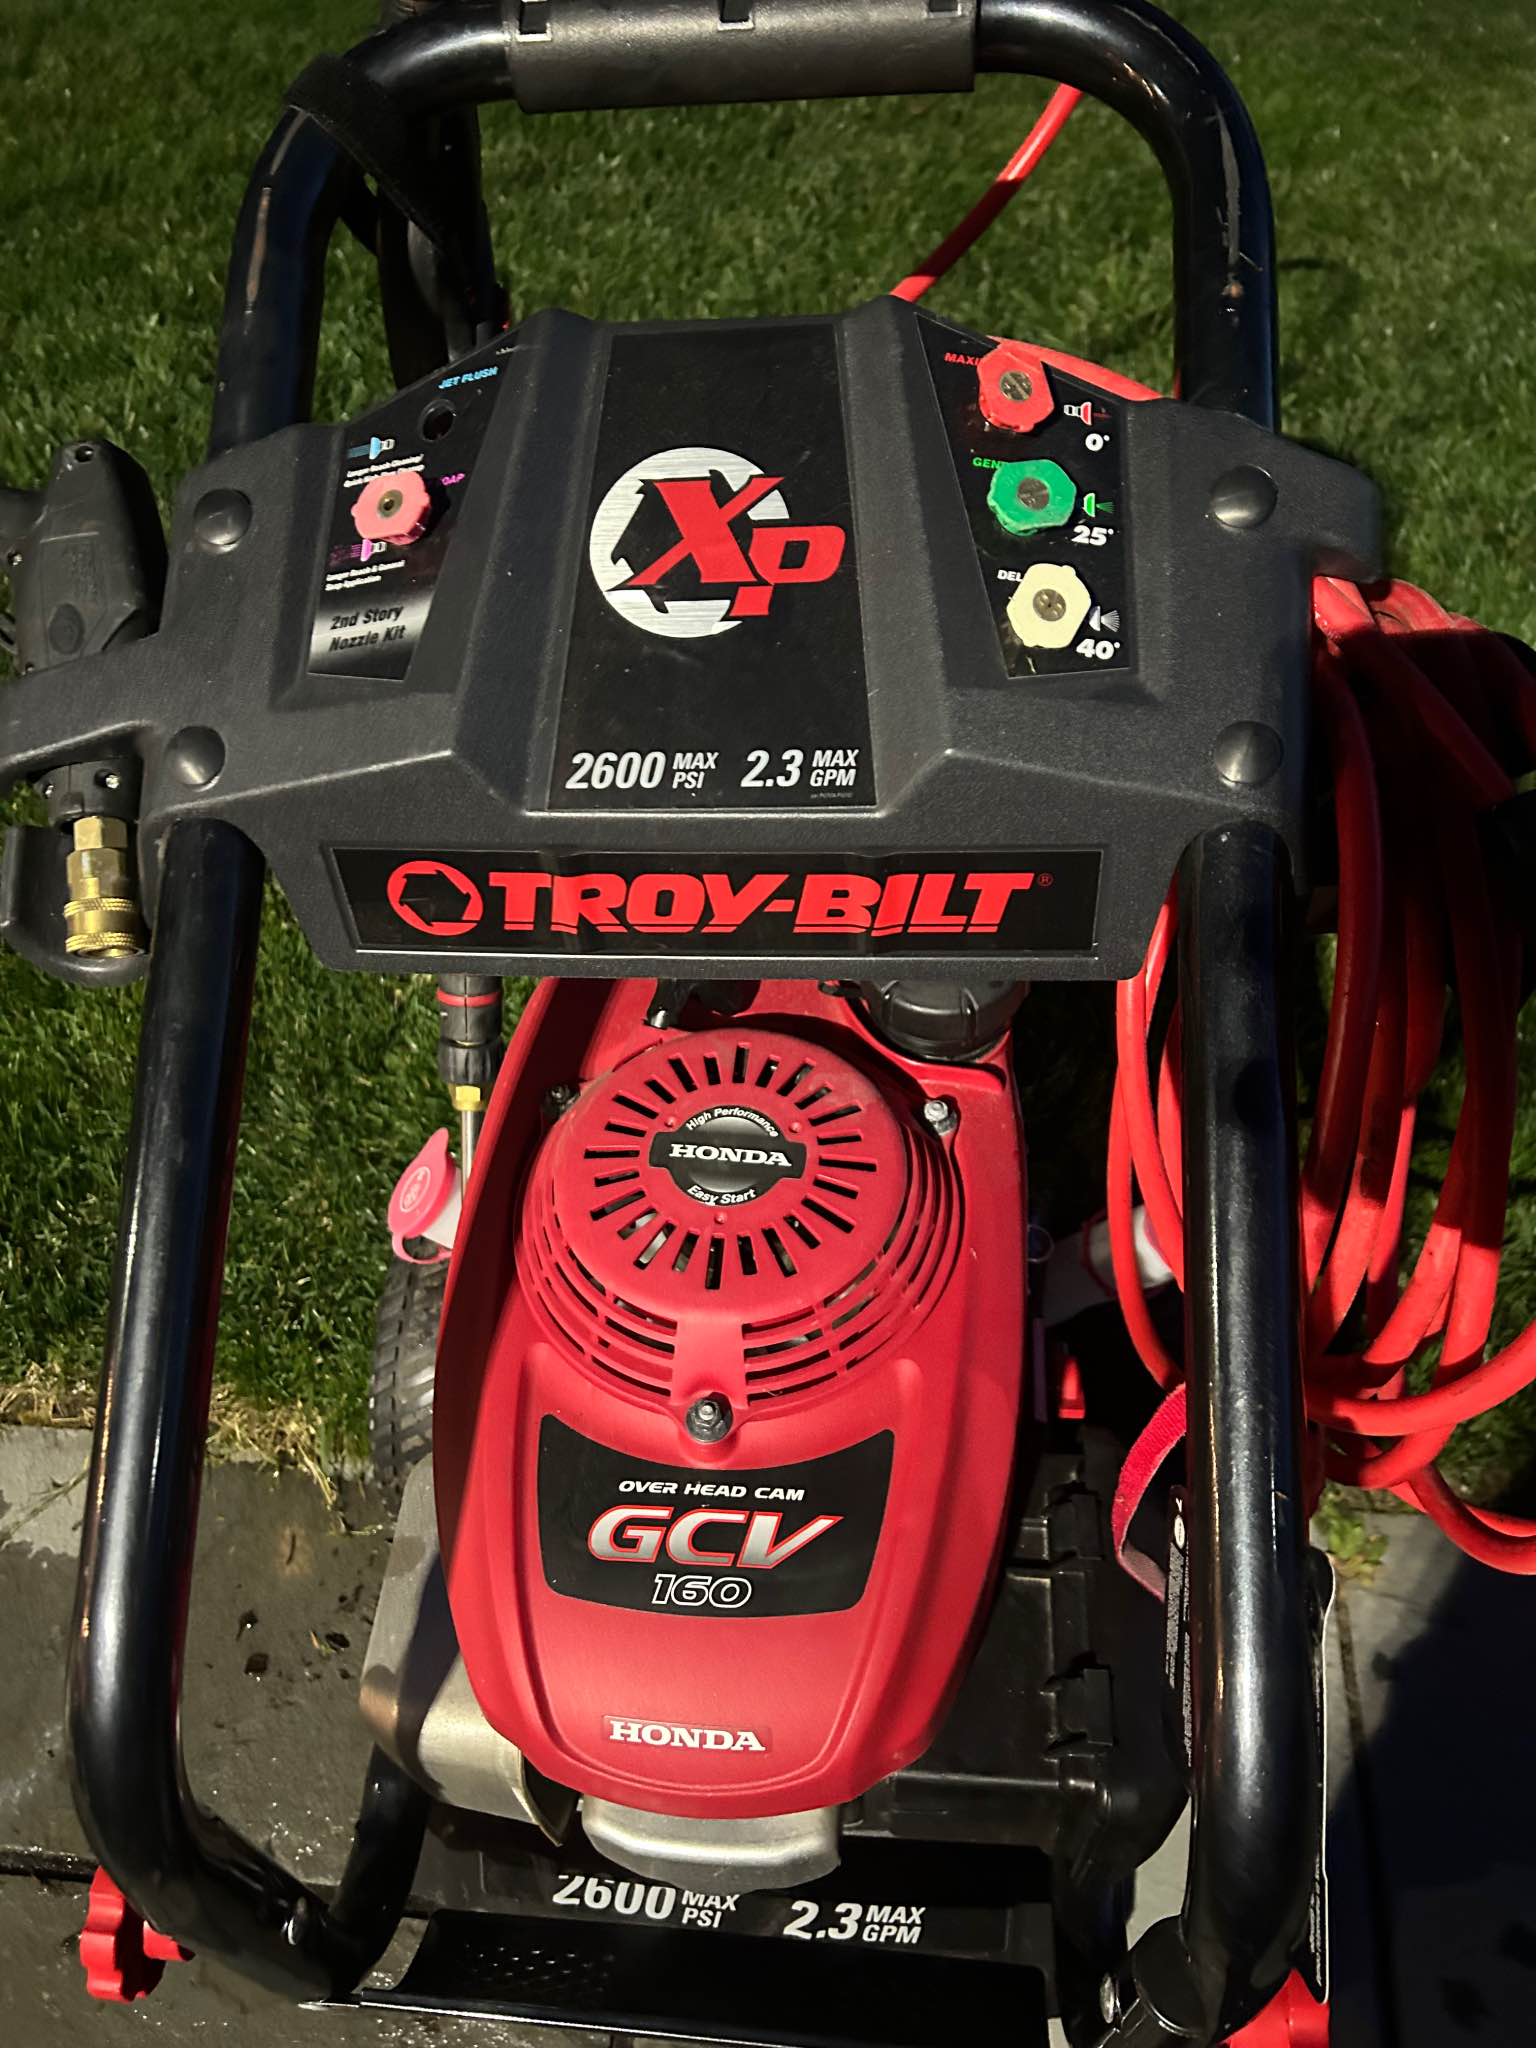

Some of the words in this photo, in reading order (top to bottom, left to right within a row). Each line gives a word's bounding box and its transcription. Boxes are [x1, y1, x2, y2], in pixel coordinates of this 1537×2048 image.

[944, 352, 980, 367] MAXI
[438, 375, 461, 389] JET
[972, 457, 1001, 470] GEN
[996, 569, 1023, 583] DEL
[330, 612, 361, 631] 2nd
[363, 606, 404, 624] Story
[328, 630, 380, 652] Nozzle
[383, 624, 406, 642] Kit
[564, 751, 667, 790] 2600
[672, 751, 720, 770] MAX
[740, 749, 805, 788] 2.3
[811, 748, 861, 768] MAX
[809, 768, 858, 787] GPM
[671, 771, 706, 790] PSI
[488, 871, 1036, 937] TROY-BILT
[685, 1112, 712, 1131] High
[714, 1107, 779, 1138] Performance
[668, 1143, 793, 1167] HONDA
[687, 1184, 719, 1206] Easy
[720, 1188, 757, 1205] Start
[618, 1480, 678, 1495] OVER
[684, 1482, 747, 1498] HEAD
[754, 1487, 805, 1501] CAM
[587, 1504, 844, 1570] GCV
[651, 1573, 752, 1609] 160
[609, 1720, 766, 1751] HONDA
[552, 1874, 677, 1920] 2600
[681, 1890, 741, 1912] MAX
[681, 1908, 723, 1929] PSI
[782, 1900, 863, 1940] 2.3
[866, 1904, 926, 1926] MAX
[862, 1924, 923, 1944] GPM
